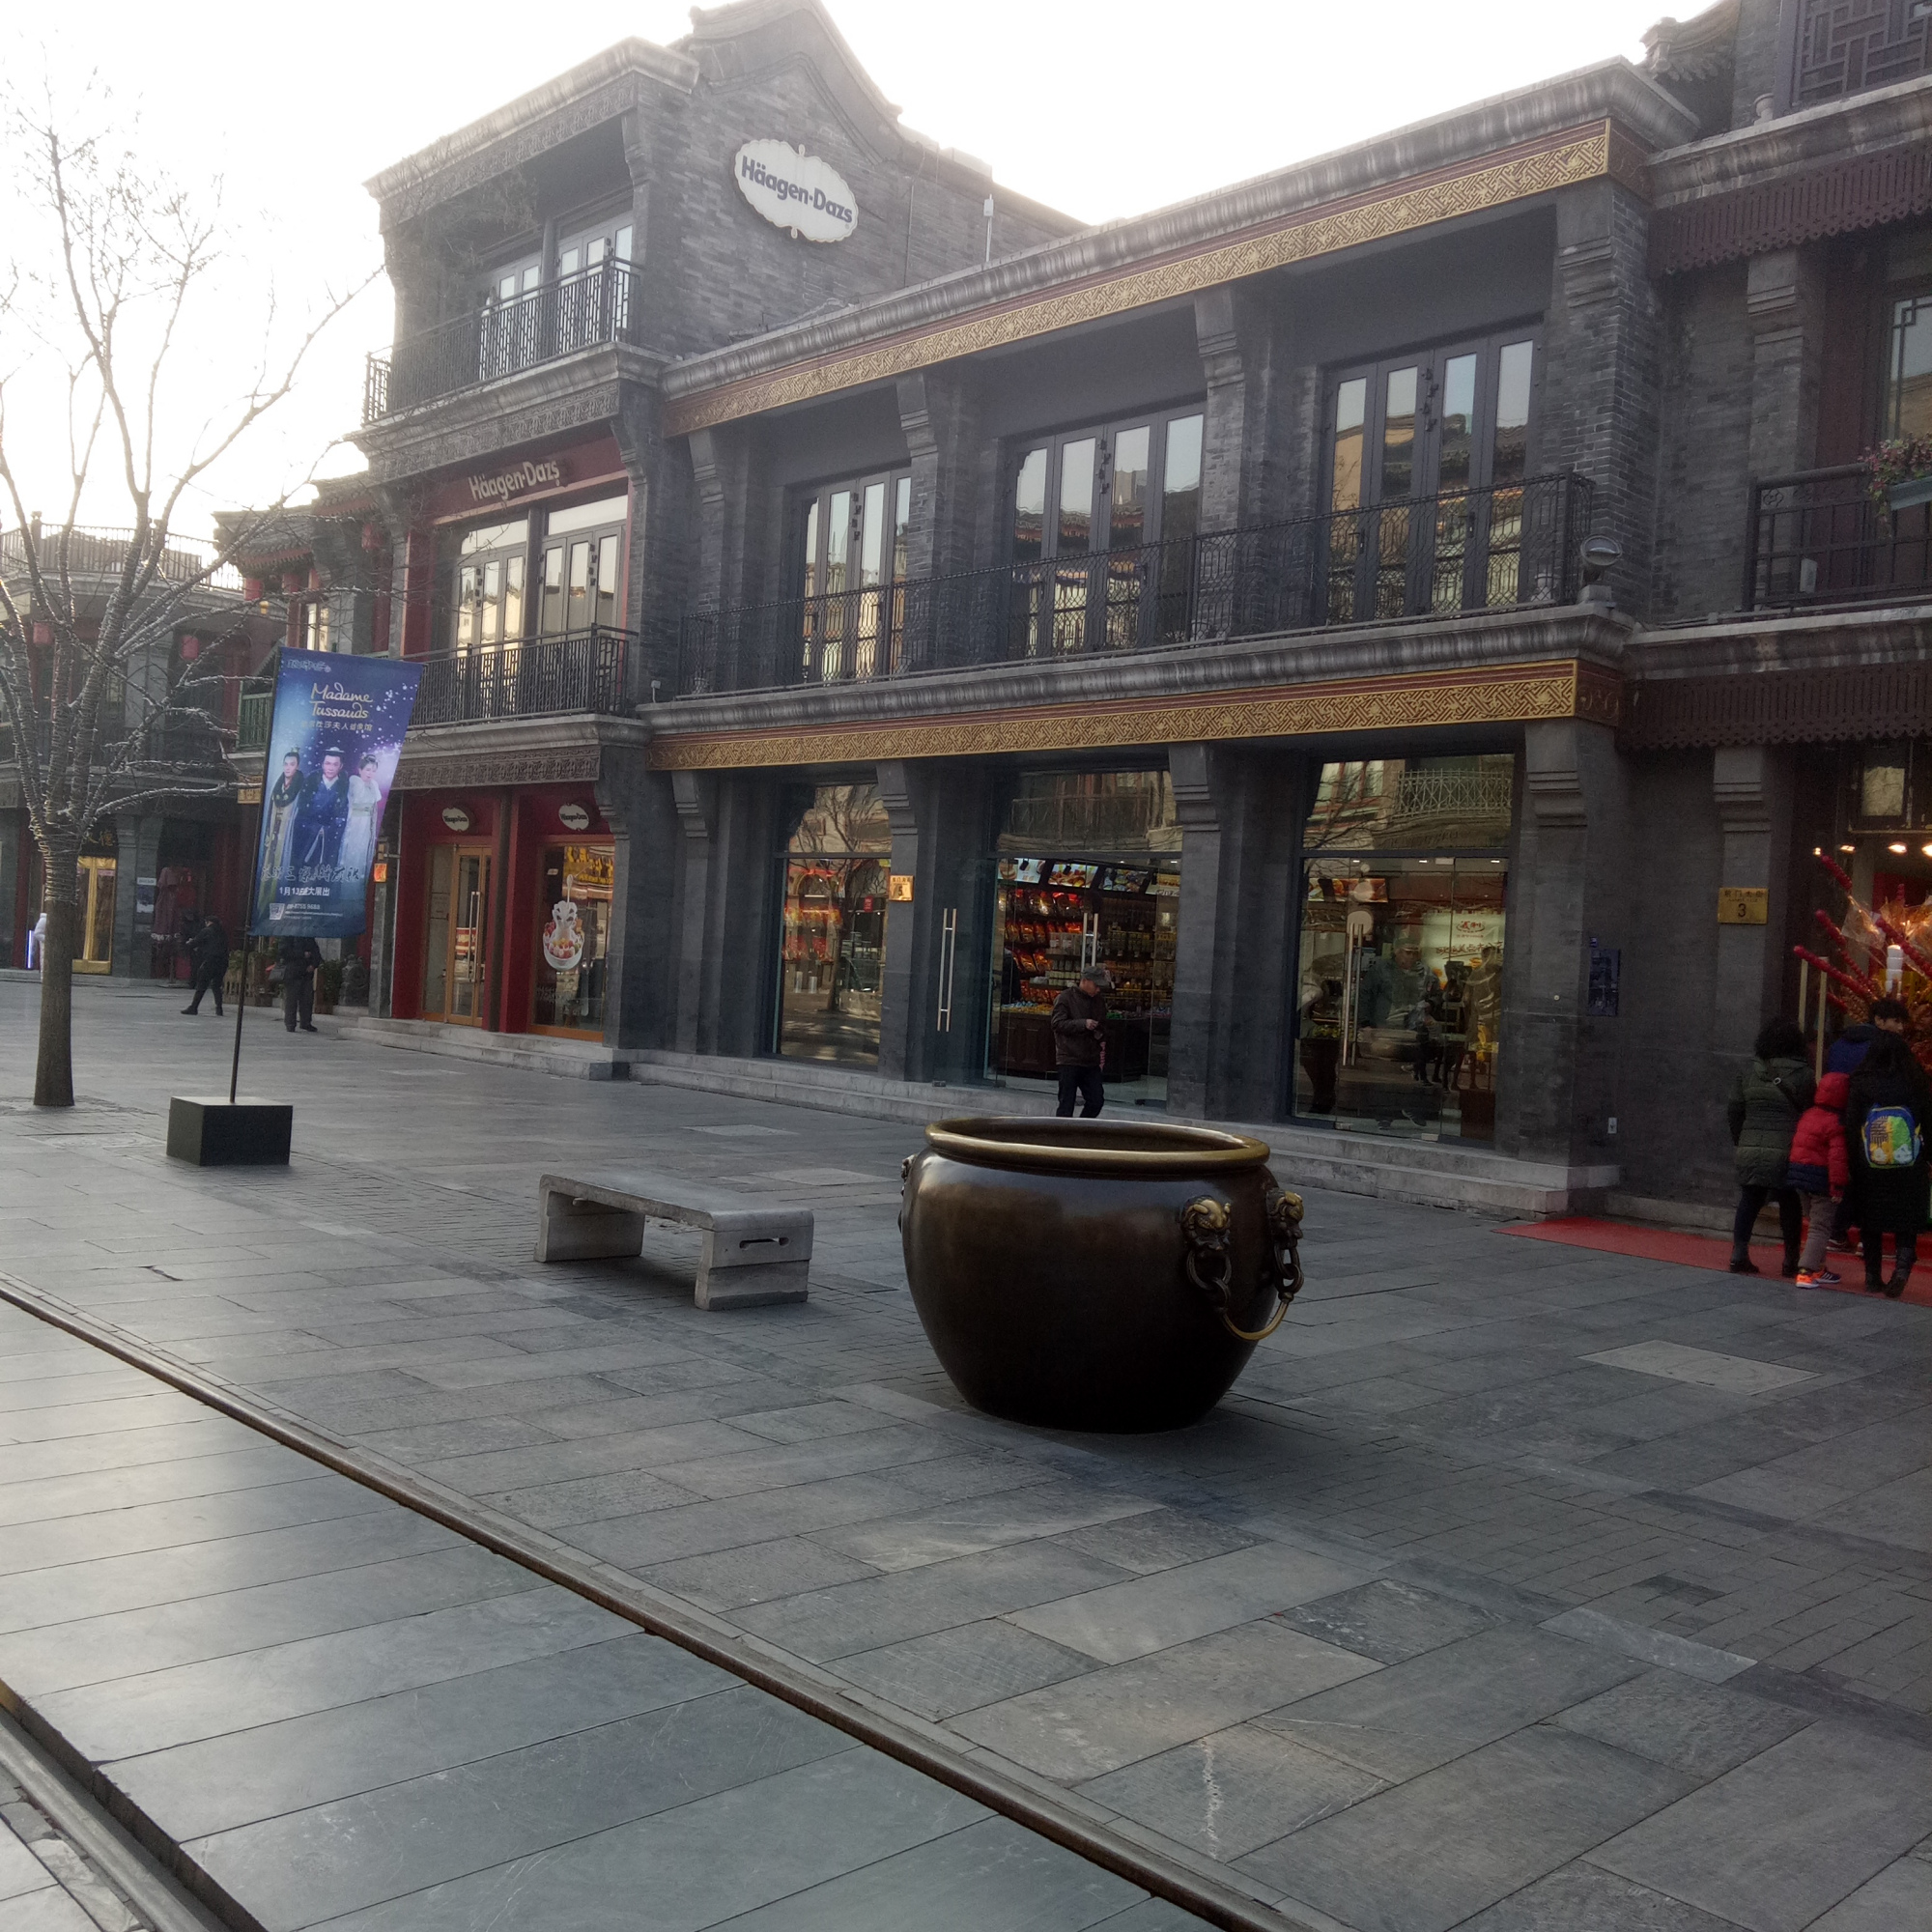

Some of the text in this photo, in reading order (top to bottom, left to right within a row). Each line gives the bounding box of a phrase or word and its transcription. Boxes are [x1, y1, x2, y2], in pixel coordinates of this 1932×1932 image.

[741, 155, 853, 223] Häagen-Dazs
[469, 459, 560, 501] Häagen-Dazs
[310, 682, 374, 703] Madame
[309, 701, 370, 719] Tussauds
[897, 886, 903, 895] 5
[1738, 902, 1747, 918] 3
